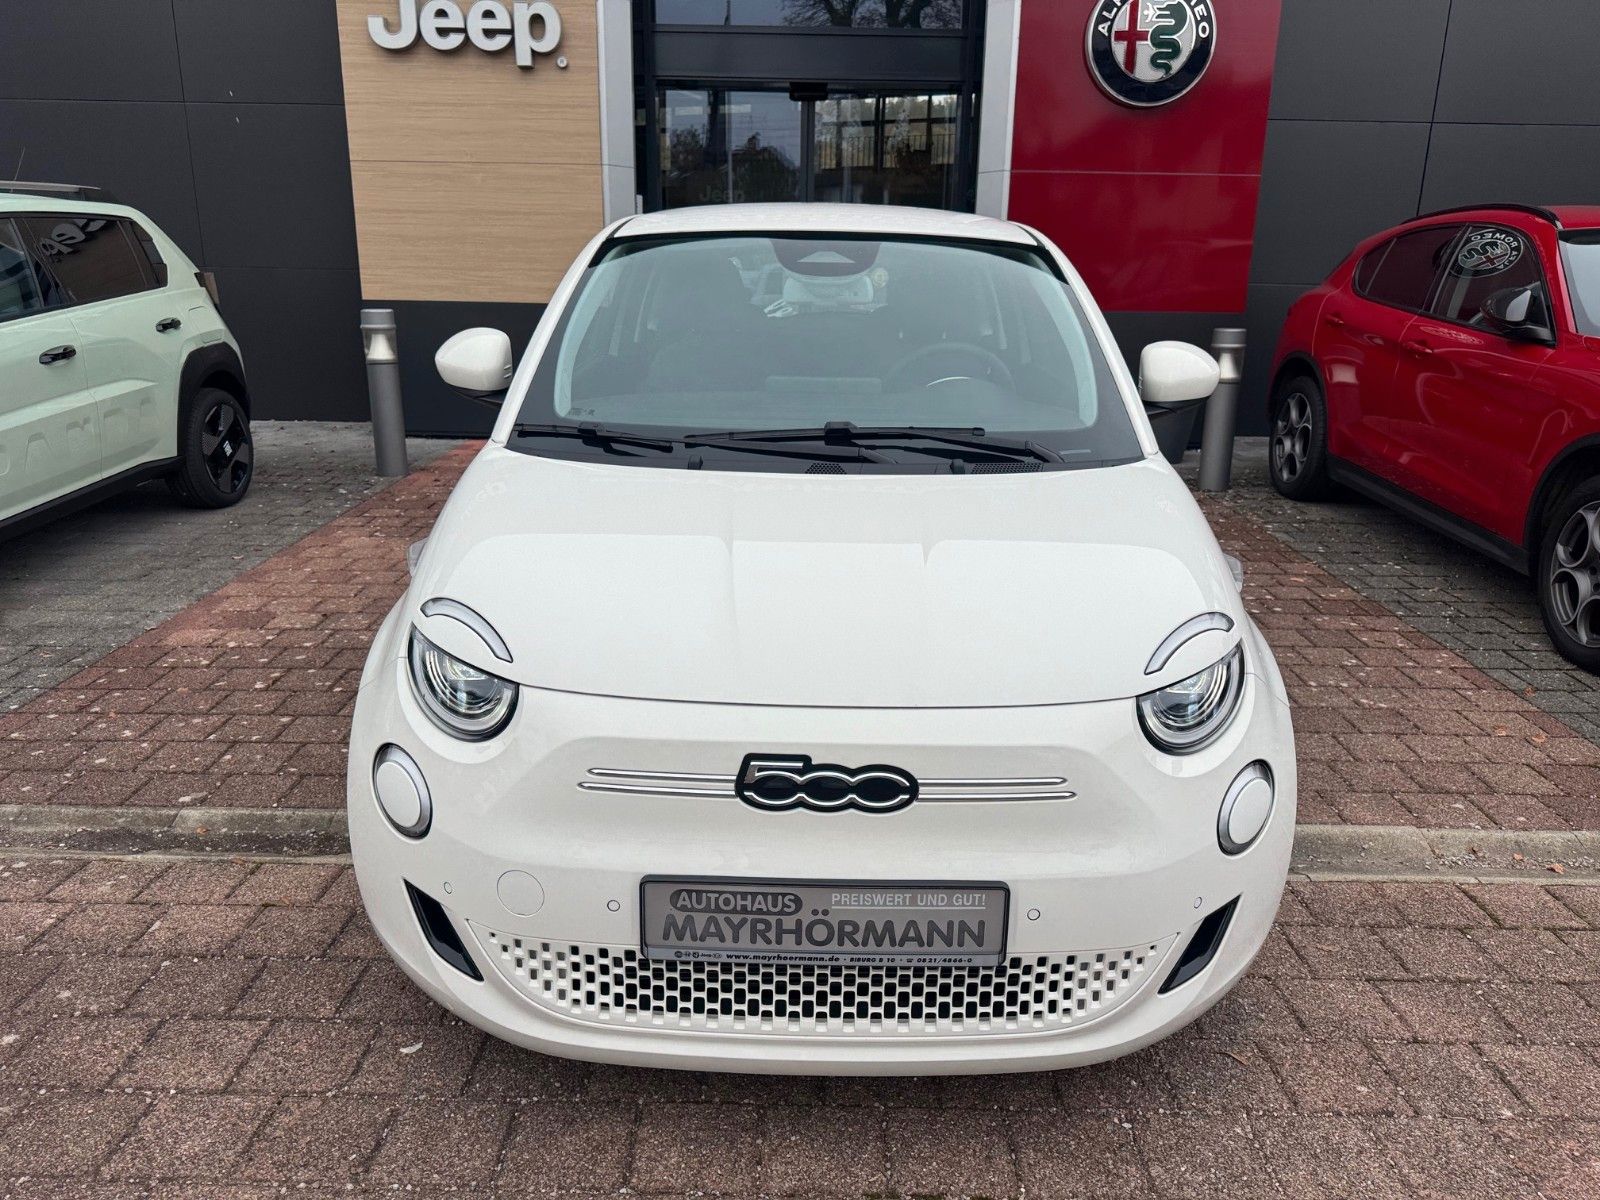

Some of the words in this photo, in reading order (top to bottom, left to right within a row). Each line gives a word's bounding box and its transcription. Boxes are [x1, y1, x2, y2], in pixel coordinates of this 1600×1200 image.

[367, 0, 562, 69] Jeep
[738, 755, 916, 811] 500
[676, 891, 796, 913] AUTOHAUS
[831, 893, 912, 906] PREISWERT
[917, 893, 947, 906] UND
[953, 893, 985, 906] GUT!
[662, 908, 986, 948] MAYRHÖRMANN
[726, 953, 840, 962] www.mayrhoermann.de
